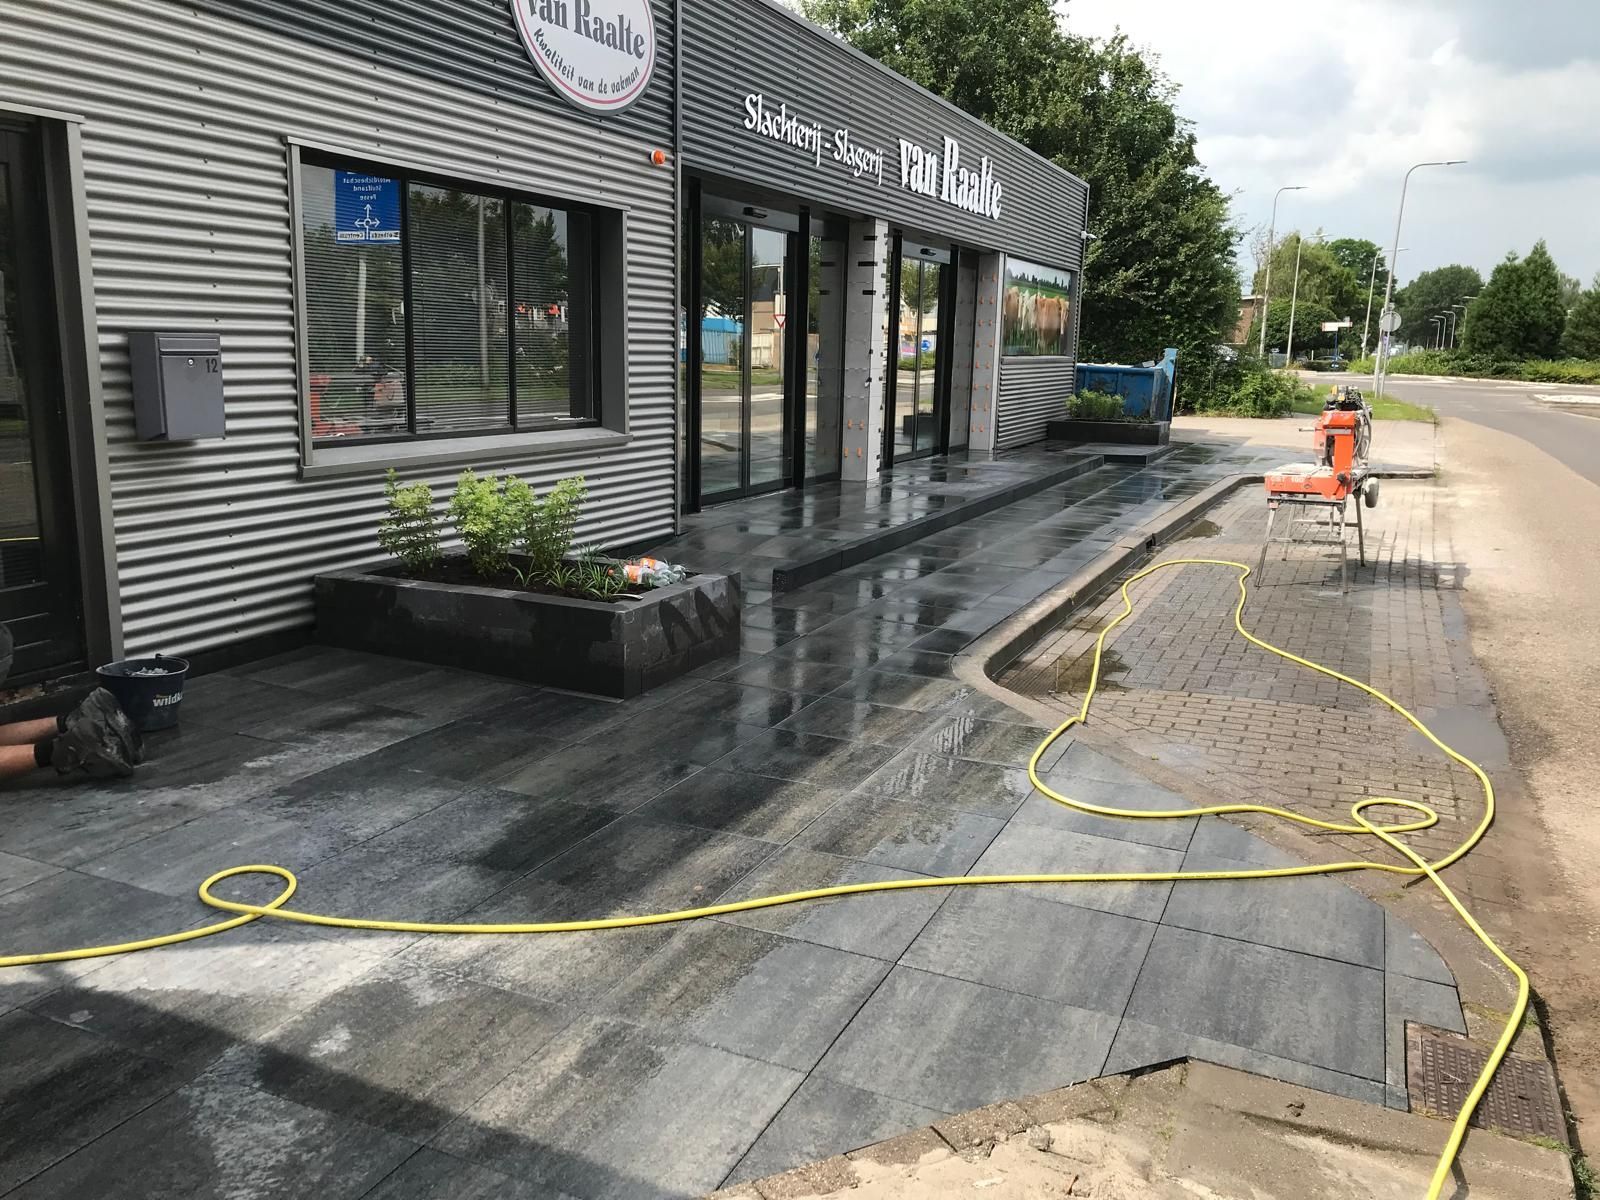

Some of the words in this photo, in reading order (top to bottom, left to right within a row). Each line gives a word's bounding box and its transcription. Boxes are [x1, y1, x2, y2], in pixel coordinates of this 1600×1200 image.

[528, 0, 568, 30] van
[574, 0, 645, 59] Raalte
[534, 27, 575, 82] Kwaliteit
[578, 75, 594, 91] van
[598, 78, 608, 94] de
[611, 66, 640, 94] vakman
[743, 93, 822, 168] Slachterij
[833, 129, 883, 186] Slagerij
[899, 138, 938, 198] van
[940, 135, 1002, 220] Raalte
[205, 358, 219, 374] 12
